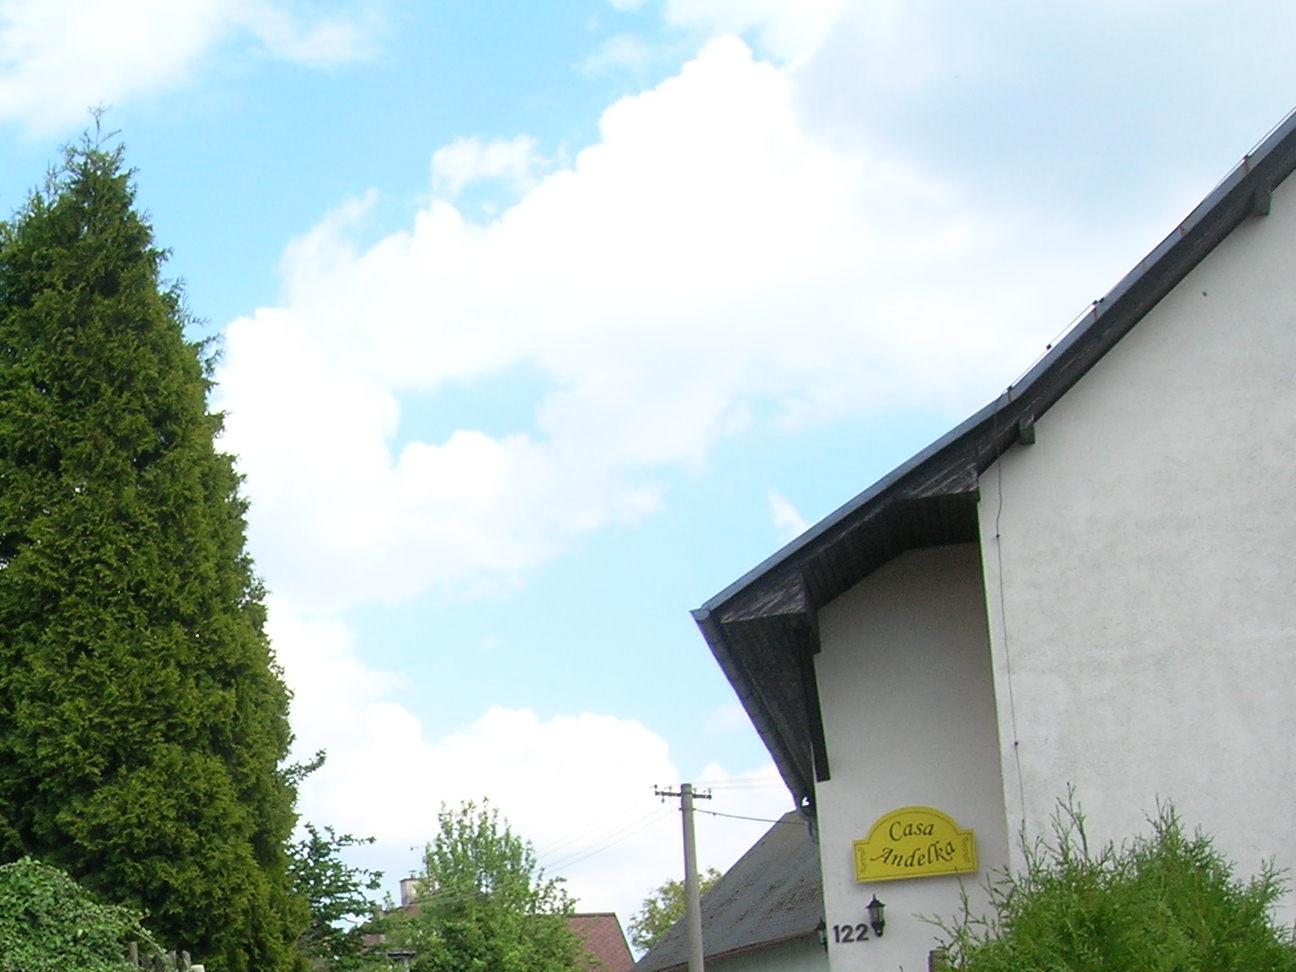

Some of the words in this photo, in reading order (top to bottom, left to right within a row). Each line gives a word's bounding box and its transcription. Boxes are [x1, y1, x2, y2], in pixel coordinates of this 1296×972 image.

[889, 820, 935, 842] Casa
[870, 840, 956, 868] Andelka
[832, 923, 870, 943] 122
